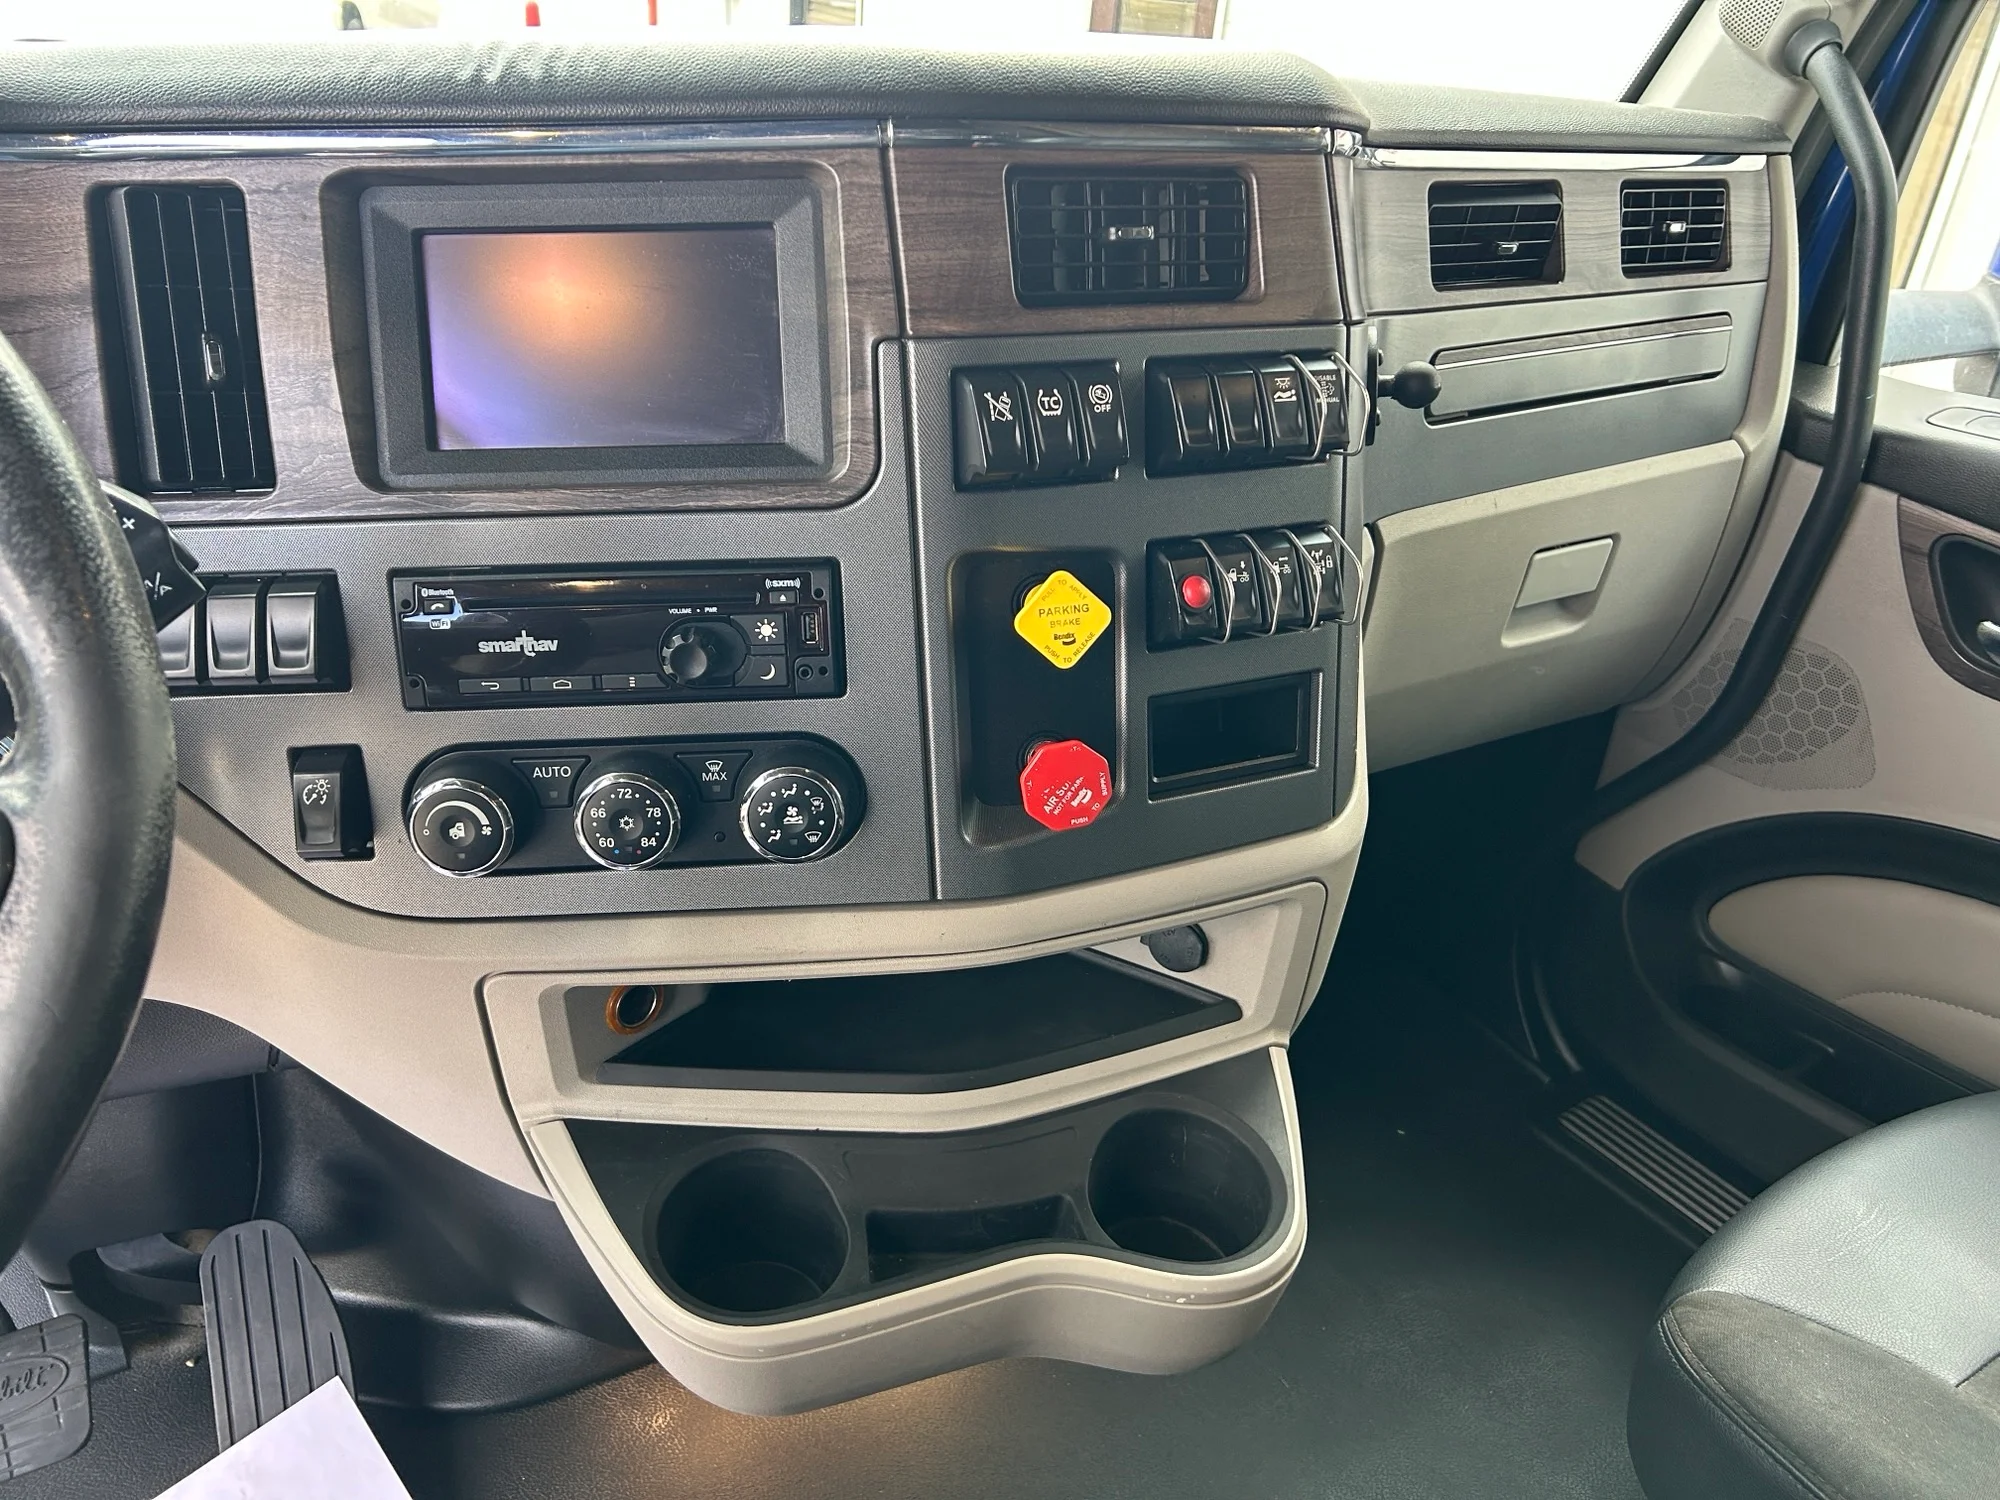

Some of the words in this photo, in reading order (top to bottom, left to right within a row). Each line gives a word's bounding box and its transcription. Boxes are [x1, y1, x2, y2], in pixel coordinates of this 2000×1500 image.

[1041, 397, 1060, 410] TC
[1094, 404, 1112, 413] OFF
[428, 588, 454, 596] Bluetooth
[1038, 603, 1090, 618] PARKING
[1050, 617, 1081, 629] BRAKE
[478, 629, 559, 657] smartnav
[1044, 644, 1060, 660] PUSH
[1072, 631, 1096, 658] RELEASE
[533, 766, 572, 778] AUTO
[702, 772, 728, 782] MAX
[617, 788, 633, 799] 72
[1070, 816, 1089, 825] PUSH
[1091, 802, 1101, 812] TO
[1099, 771, 1108, 796] SUPPLY
[1043, 795, 1060, 814] AIR
[1053, 801, 1065, 816] NOT
[1062, 790, 1074, 804] FOR
[590, 807, 607, 818] 66
[646, 807, 662, 818] 78
[598, 837, 615, 848] 60
[640, 837, 657, 848] 84
